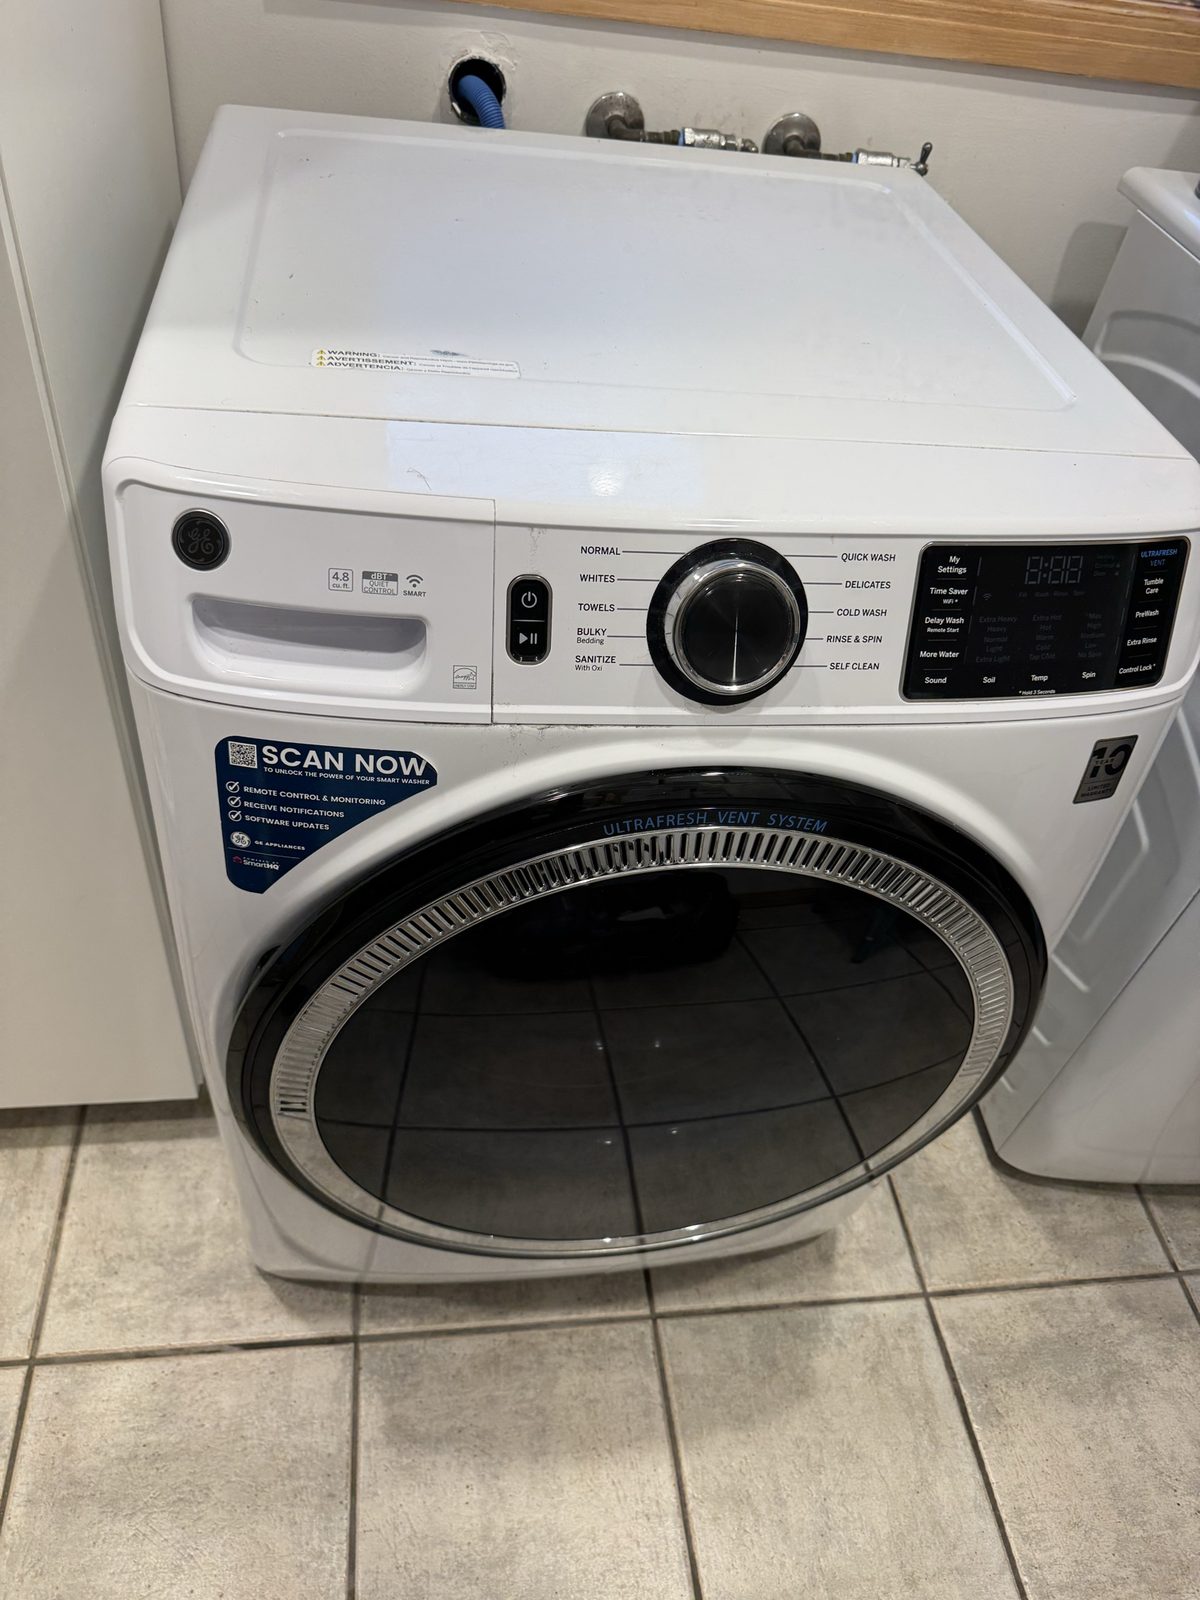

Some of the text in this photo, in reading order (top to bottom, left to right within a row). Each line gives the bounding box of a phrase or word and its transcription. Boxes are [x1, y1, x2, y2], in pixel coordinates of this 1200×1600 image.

[328, 356, 416, 366] AVERTISSEMENT:
[327, 362, 403, 370] ADVERTENCIA:
[580, 546, 621, 555] NORMAL
[1141, 548, 1177, 558] ULTRAFRESH
[841, 553, 896, 562] QUICK WASH
[949, 556, 960, 564] My
[938, 566, 967, 574] Settings
[332, 572, 350, 582] 4.8
[580, 574, 615, 583] WHITES
[845, 581, 891, 589] DELICATES
[578, 603, 615, 612] TOWELS
[1136, 609, 1159, 618] PreWash
[925, 617, 944, 625] Delay
[577, 628, 607, 636] BULKY
[826, 635, 852, 643] RINSE
[853, 635, 860, 643] &
[575, 655, 616, 663] SANITIZE
[830, 662, 880, 670] SELF CLEAN
[1119, 666, 1139, 674] Control
[983, 676, 996, 684] Soil
[1031, 674, 1048, 682] Temp
[262, 745, 427, 776] SCAN NOW
[275, 768, 302, 776] UNLOCK
[244, 786, 278, 796] REMOTE
[280, 791, 320, 801] CONTROL
[331, 796, 386, 806] MONITORING
[244, 801, 344, 817] RECEIVE NOTIFICATIONS
[245, 815, 330, 830] SOFTWARE UPDATES
[602, 811, 828, 836] ULTRAFRESH VENT SYSTEM
[265, 842, 305, 850] APPLIANCES
[243, 860, 280, 870] SmartHQ
